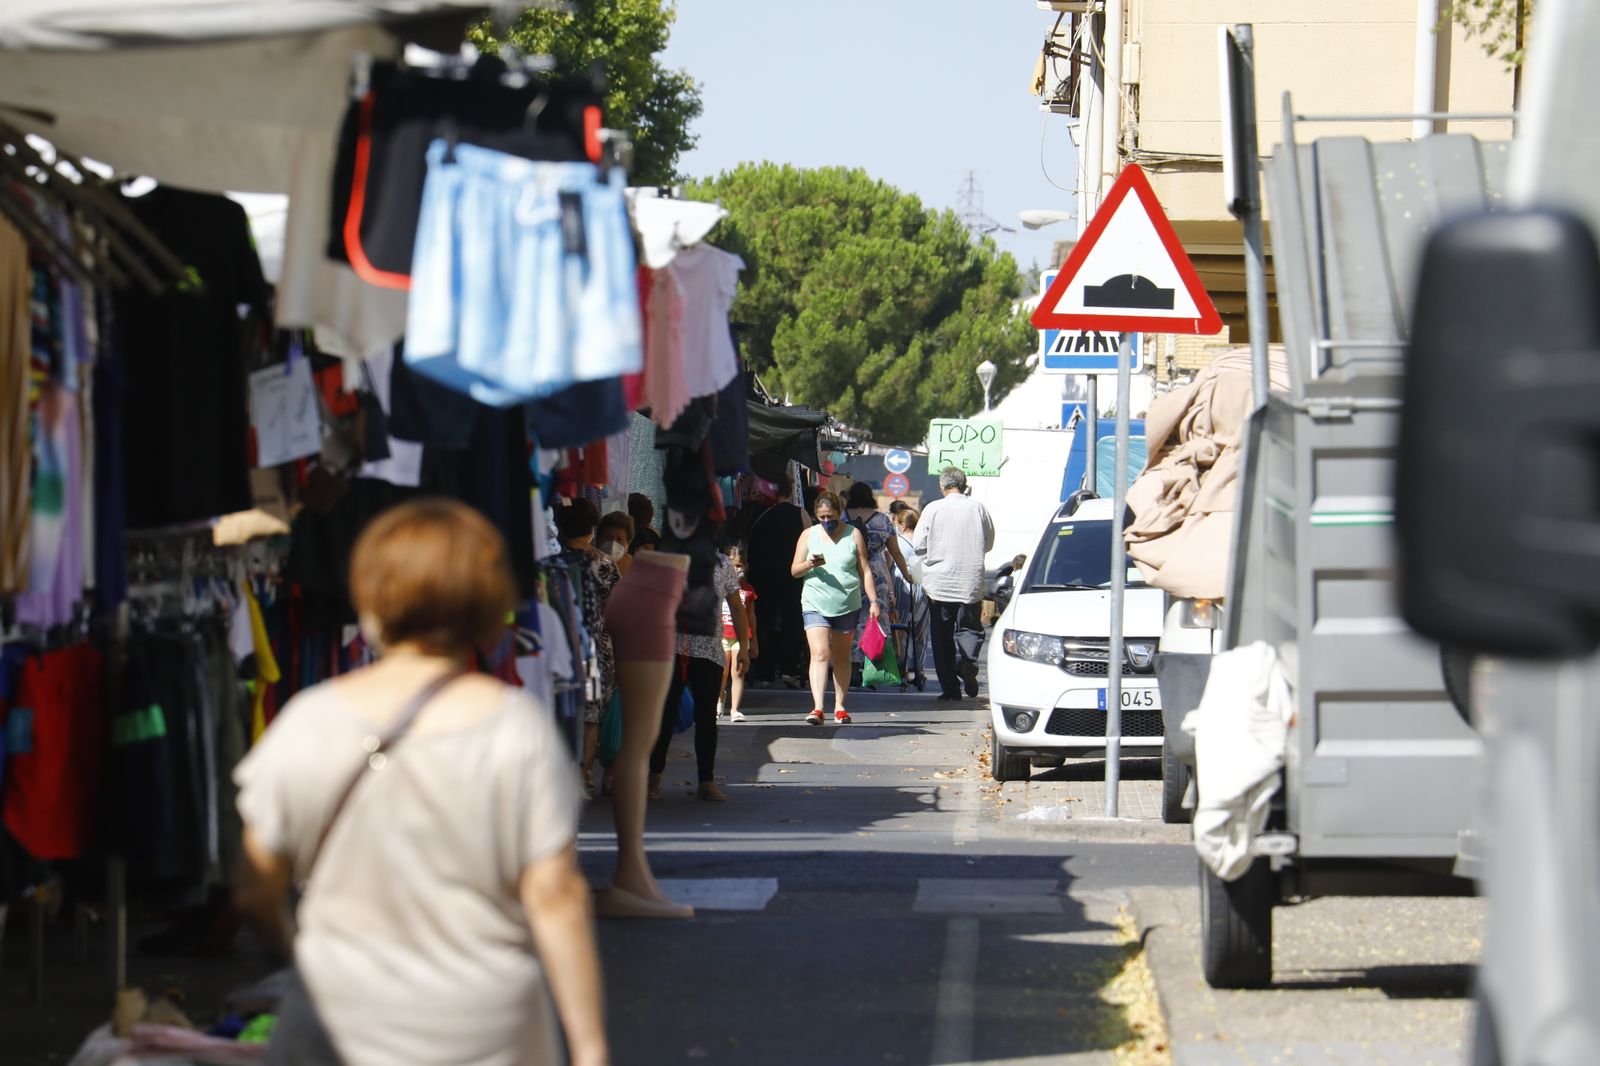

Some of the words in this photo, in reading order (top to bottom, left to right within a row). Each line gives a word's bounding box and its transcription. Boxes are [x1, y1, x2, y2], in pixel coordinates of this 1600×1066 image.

[932, 424, 996, 444] TODO
[937, 450, 955, 474] 5
[1121, 691, 1154, 707] 045
